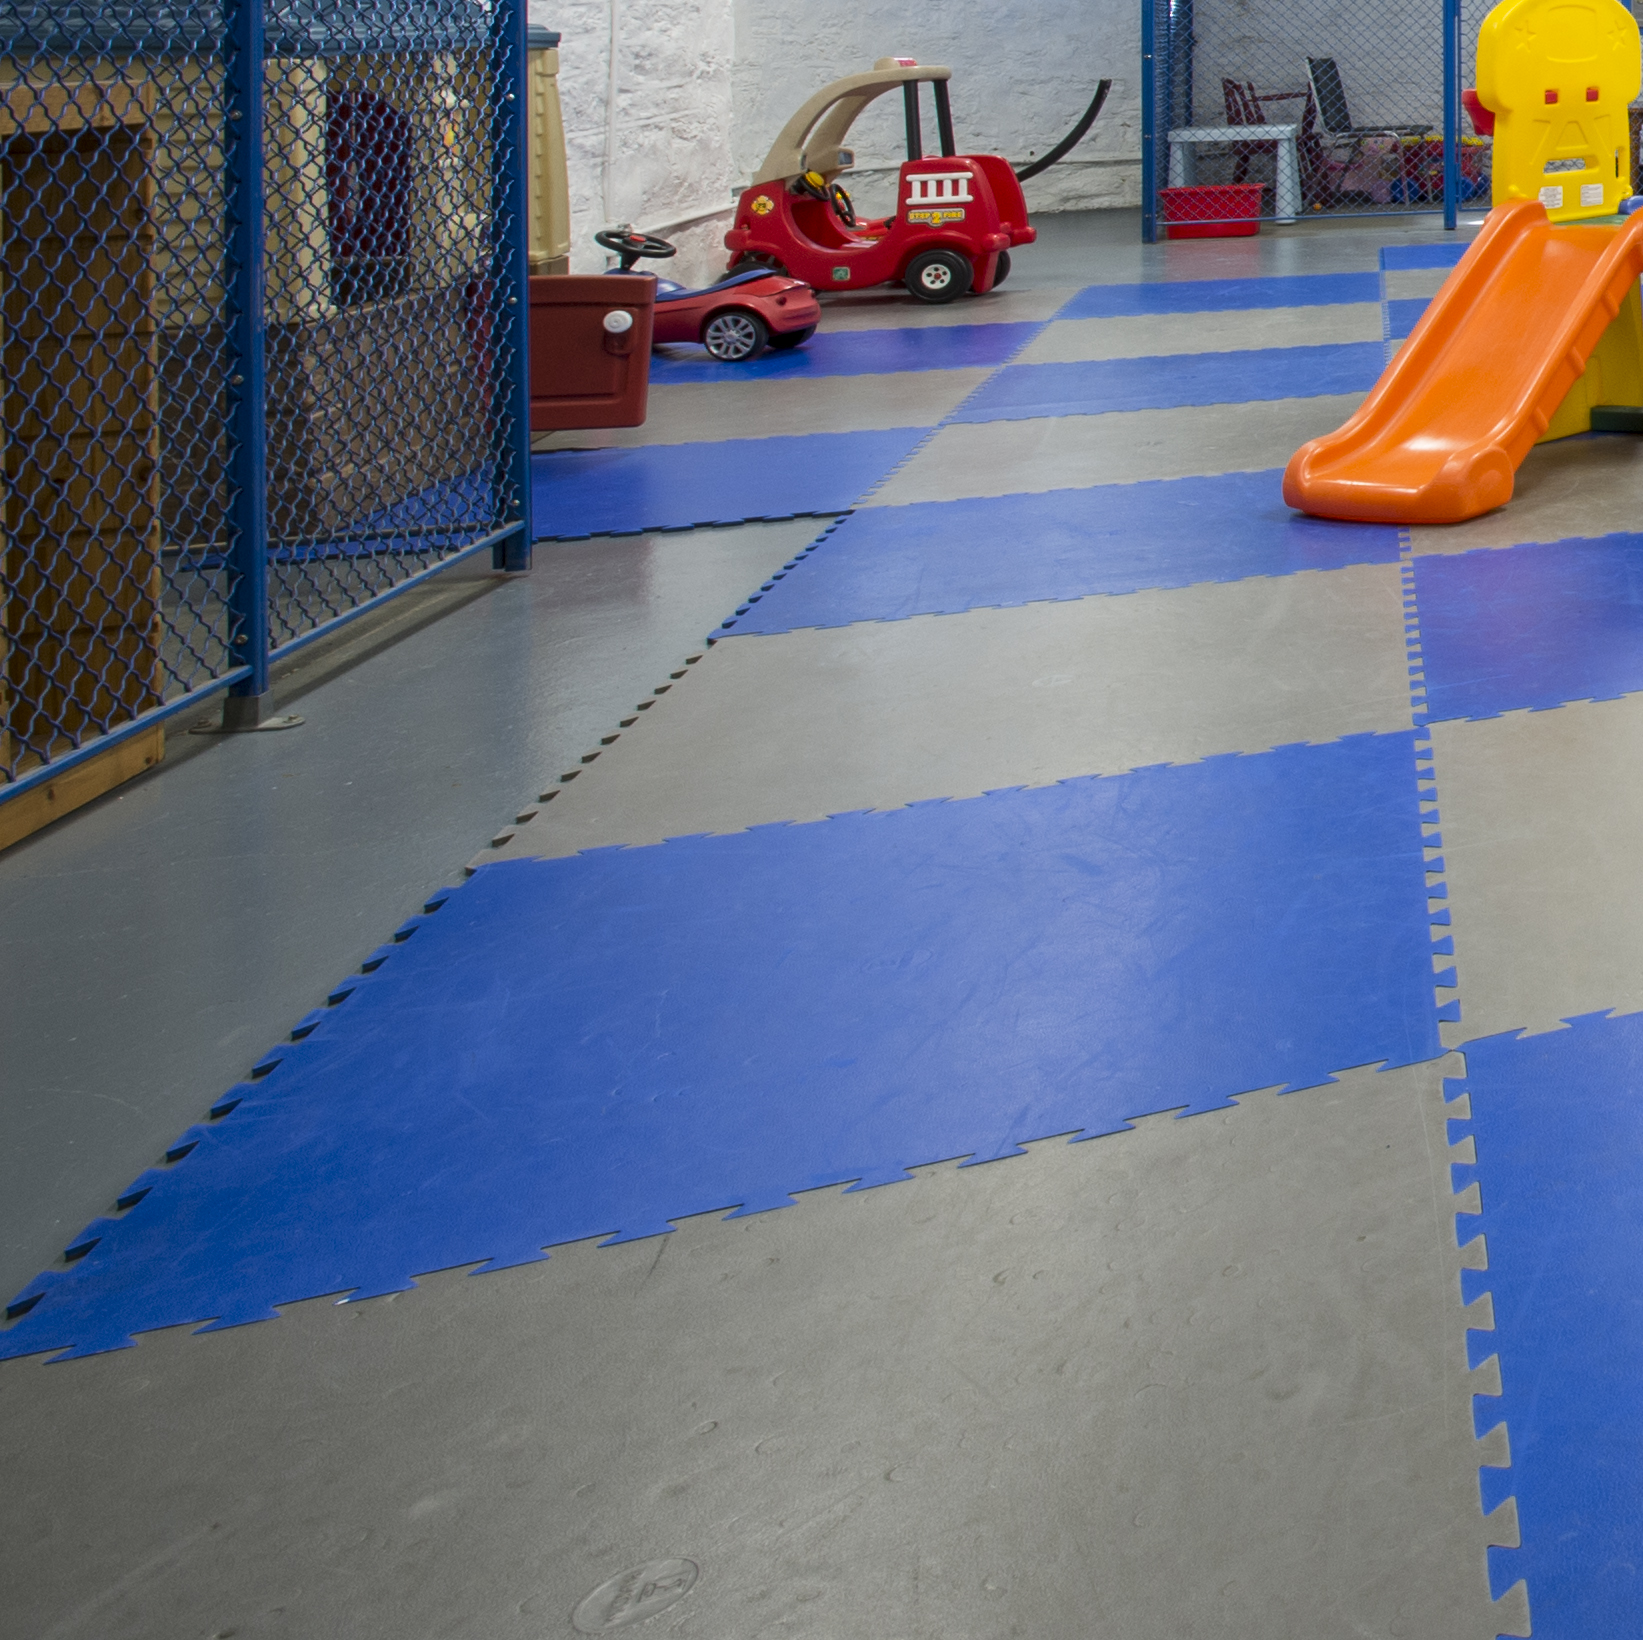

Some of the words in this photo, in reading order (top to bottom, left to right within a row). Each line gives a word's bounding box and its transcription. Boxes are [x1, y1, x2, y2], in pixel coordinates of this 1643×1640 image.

[909, 212, 931, 220] STEP
[931, 211, 941, 224] 2
[943, 211, 962, 219] FIRE
